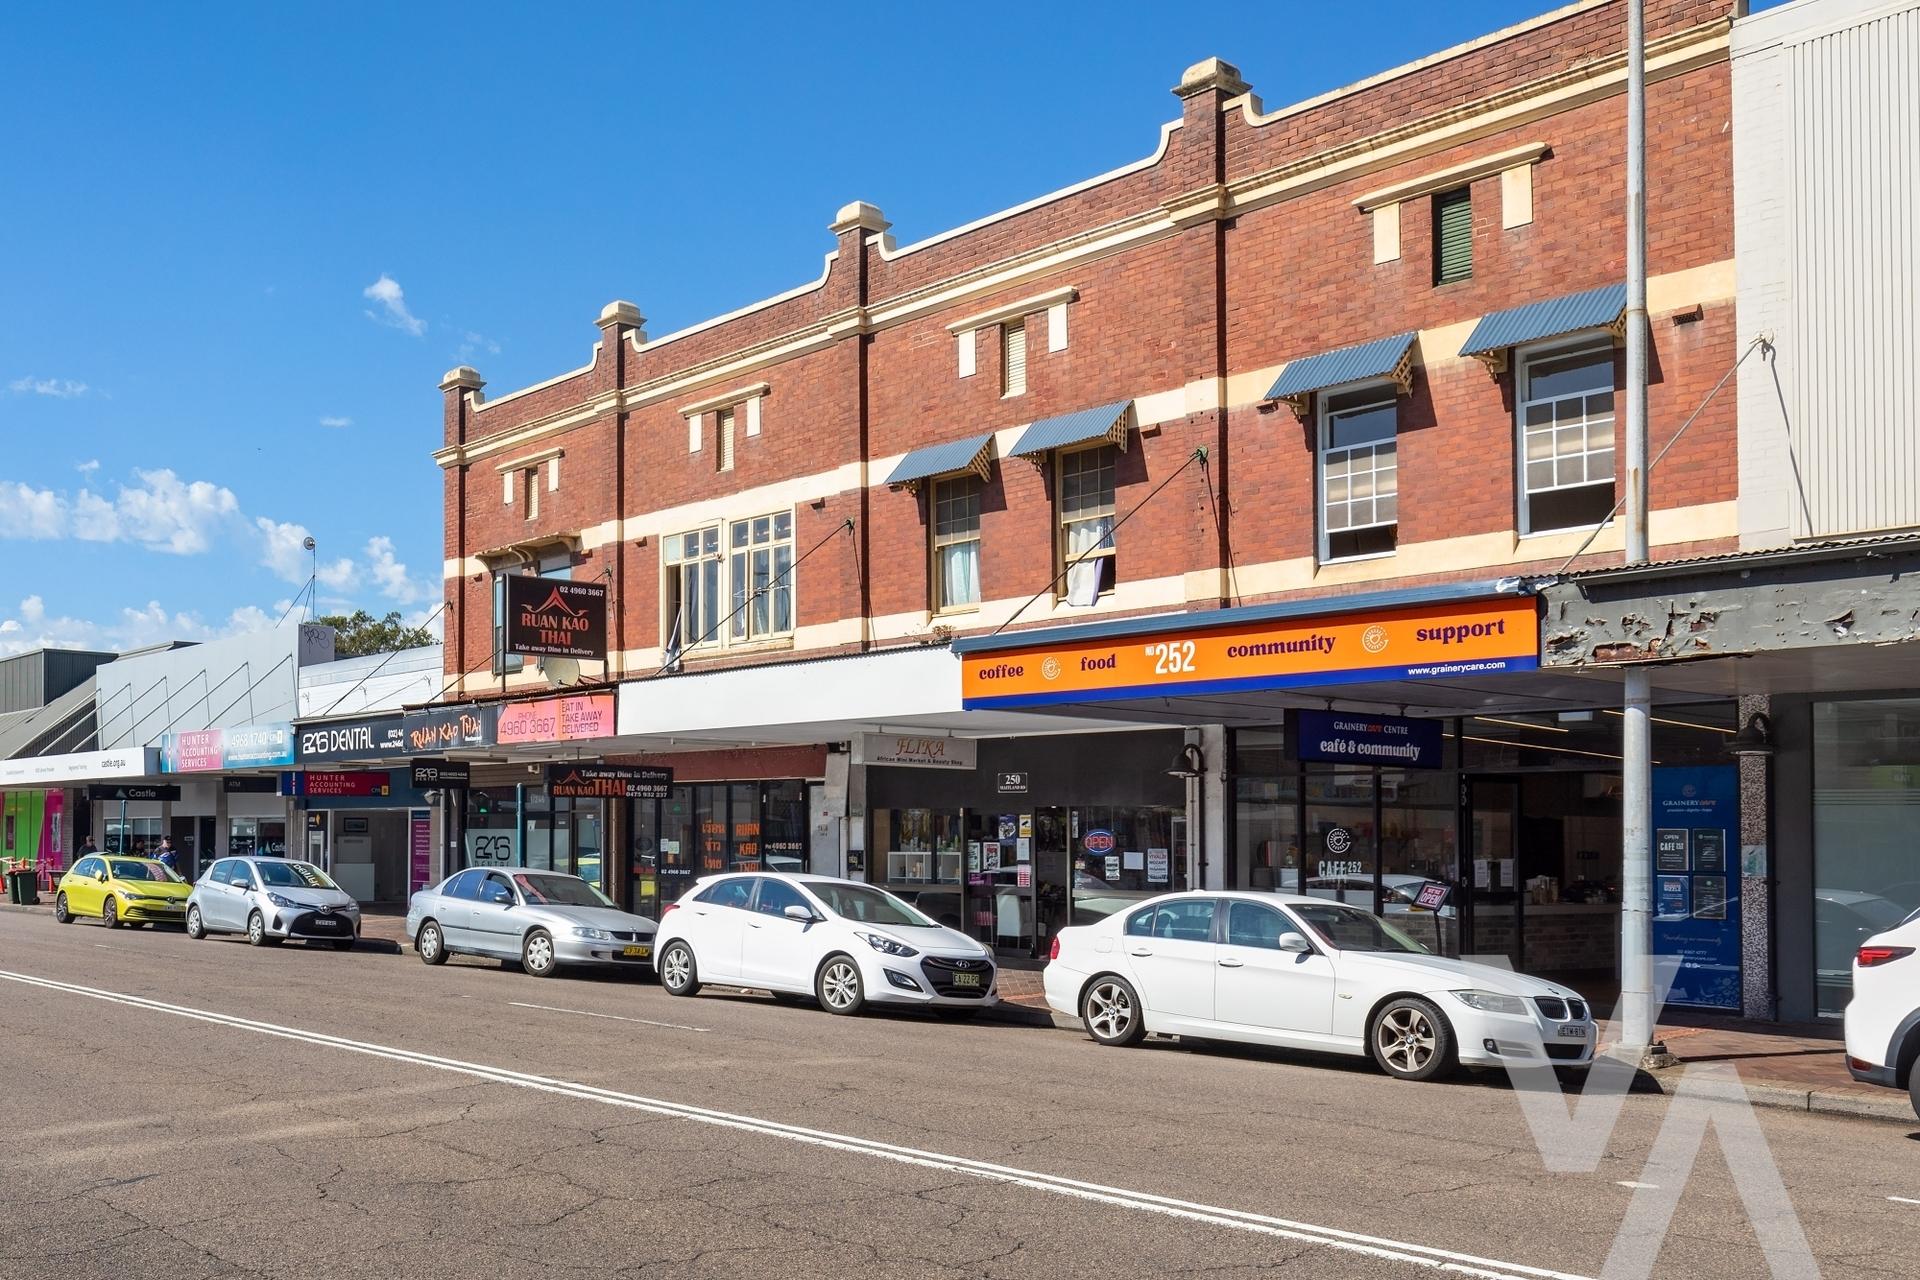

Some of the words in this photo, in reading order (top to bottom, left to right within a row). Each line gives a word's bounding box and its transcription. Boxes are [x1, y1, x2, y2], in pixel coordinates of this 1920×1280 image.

[521, 613, 557, 628] RUAN
[562, 616, 589, 631] KAO
[539, 630, 571, 645] THAI
[570, 648, 594, 656] Delivery
[979, 665, 1024, 680] coffee
[1080, 654, 1116, 671] food
[1155, 640, 1195, 674] 252
[1227, 634, 1336, 658] community
[1416, 618, 1505, 645] support
[1408, 660, 1505, 675] www.grainerycare.com
[561, 703, 575, 712] EAT
[576, 702, 583, 711] IN
[561, 712, 579, 722] TAKE
[580, 710, 602, 720] AWAY
[500, 720, 526, 735] 4960
[530, 718, 555, 734] 3667
[562, 722, 599, 734] DELIVERED
[1383, 725, 1408, 735] CENTRE
[181, 734, 209, 745] HUNTER
[232, 734, 248, 747] 4968
[250, 732, 267, 746] 1740
[303, 731, 328, 754] 246
[331, 727, 374, 751] DENTAL
[410, 726, 436, 748] RUAN
[181, 746, 218, 757] ACCOUNTING
[1320, 738, 1346, 753] café
[1348, 740, 1356, 754] &
[1357, 742, 1420, 760] community
[101, 760, 126, 768] castle.org.au
[182, 758, 207, 768] SERVICES
[1006, 775, 1020, 784] 250
[129, 789, 156, 798] Castle
[553, 785, 576, 795] RUAN
[578, 786, 594, 796] KAO
[593, 779, 626, 796] THAI
[736, 823, 760, 836] RUAN
[475, 836, 510, 860] 246
[1085, 836, 1113, 848] OPEN
[1660, 842, 1675, 850] CAFE
[740, 843, 757, 855] KAO
[1318, 860, 1347, 878] CAFE
[1348, 862, 1362, 872] 252
[1421, 893, 1441, 905] OPEN
